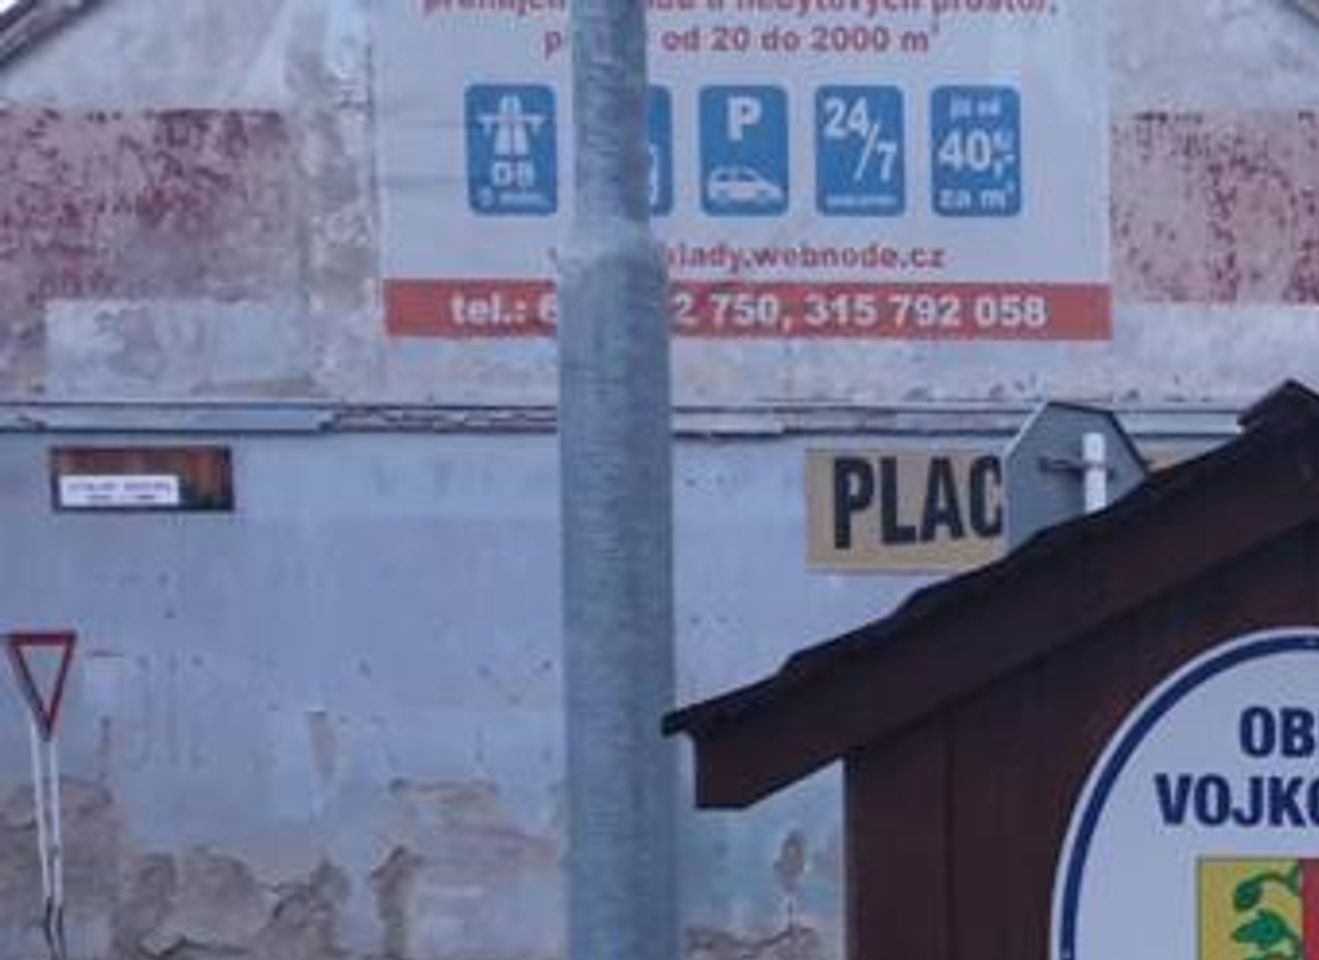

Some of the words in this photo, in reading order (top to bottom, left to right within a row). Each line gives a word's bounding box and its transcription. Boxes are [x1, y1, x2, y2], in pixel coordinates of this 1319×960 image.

[660, 28, 703, 52] od
[711, 27, 748, 52] 20
[760, 27, 802, 51] do
[810, 26, 890, 51] 2000
[728, 97, 761, 140] P
[803, 294, 877, 327] 315
[888, 294, 961, 328] 792
[974, 294, 1047, 328] 058
[832, 456, 1003, 549] PLAC
